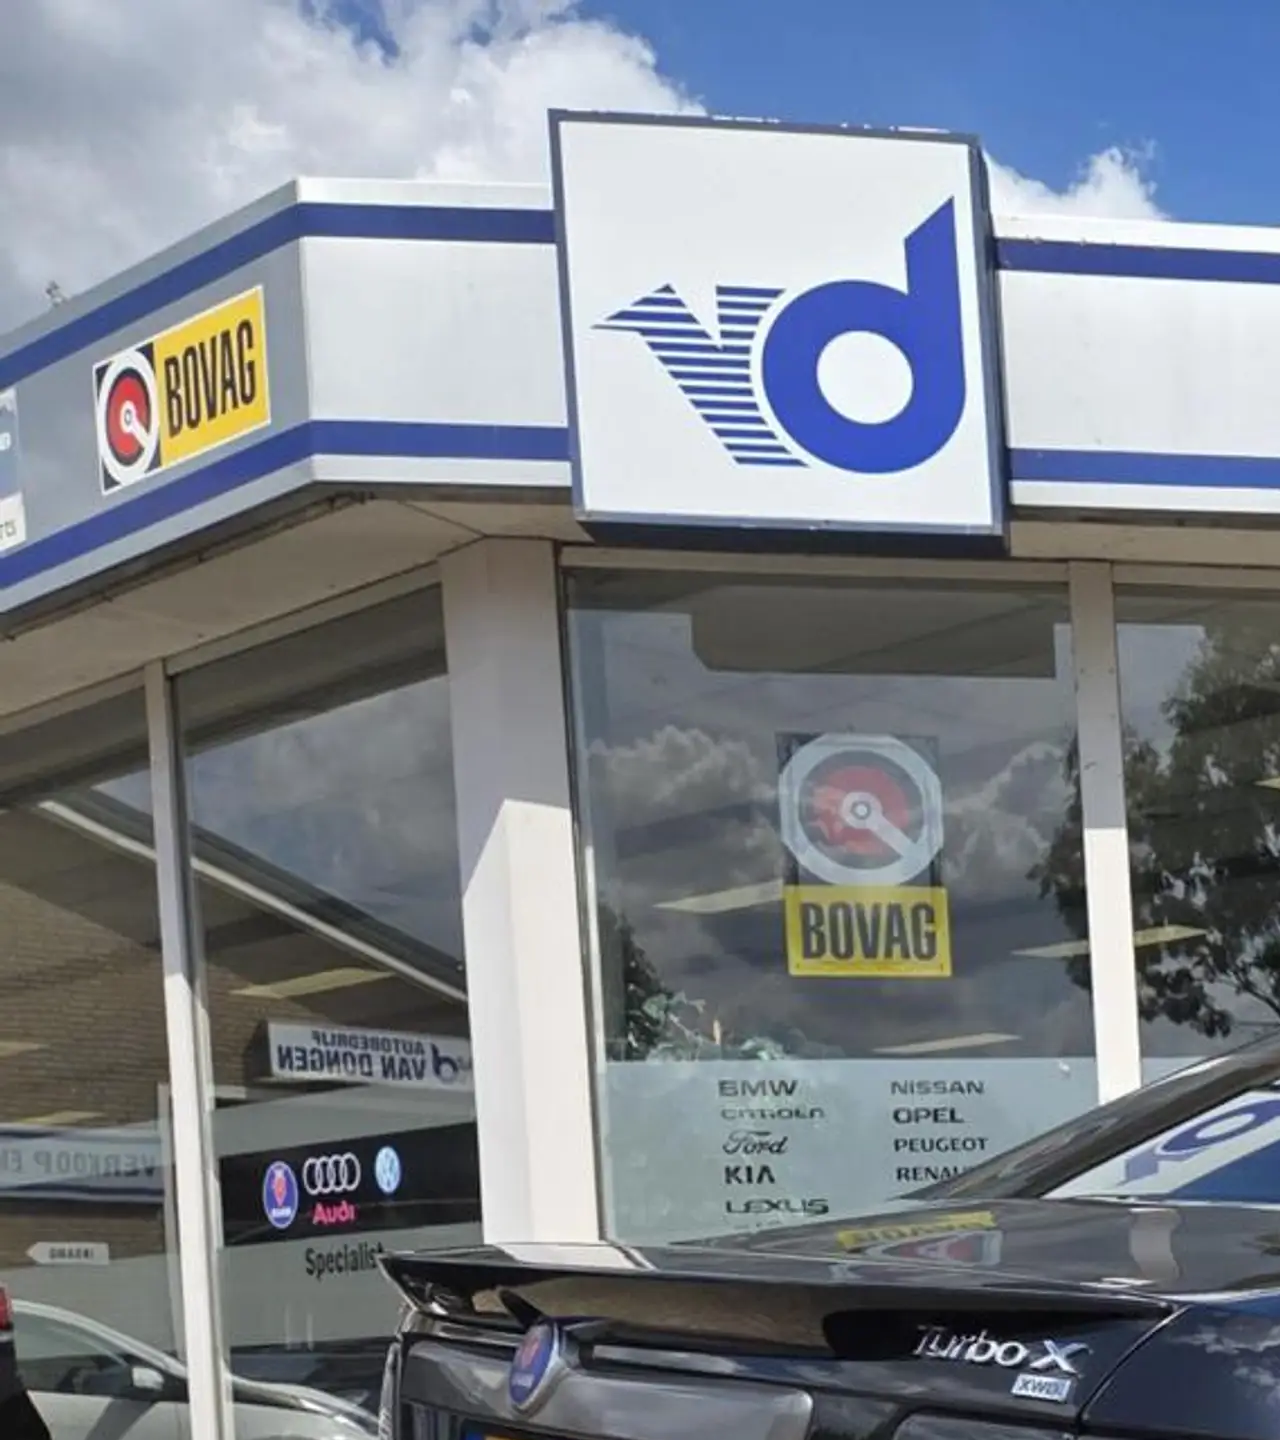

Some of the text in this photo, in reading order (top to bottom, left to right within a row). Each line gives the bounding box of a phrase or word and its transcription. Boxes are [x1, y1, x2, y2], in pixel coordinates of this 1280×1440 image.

[163, 318, 256, 437] BOVAG
[801, 902, 937, 961] BOVAG
[718, 1080, 798, 1097] BMW
[890, 1080, 985, 1095] NISSAN
[893, 1107, 964, 1124] OPEL
[722, 1130, 788, 1155] Ford
[894, 1136, 989, 1152] PEUGEOT
[725, 1165, 776, 1184] KIA
[312, 1200, 356, 1225] Audi
[726, 1198, 830, 1215] LEXUS
[913, 1324, 1094, 1379] Turbo X
[1016, 1376, 1063, 1398] XWD
